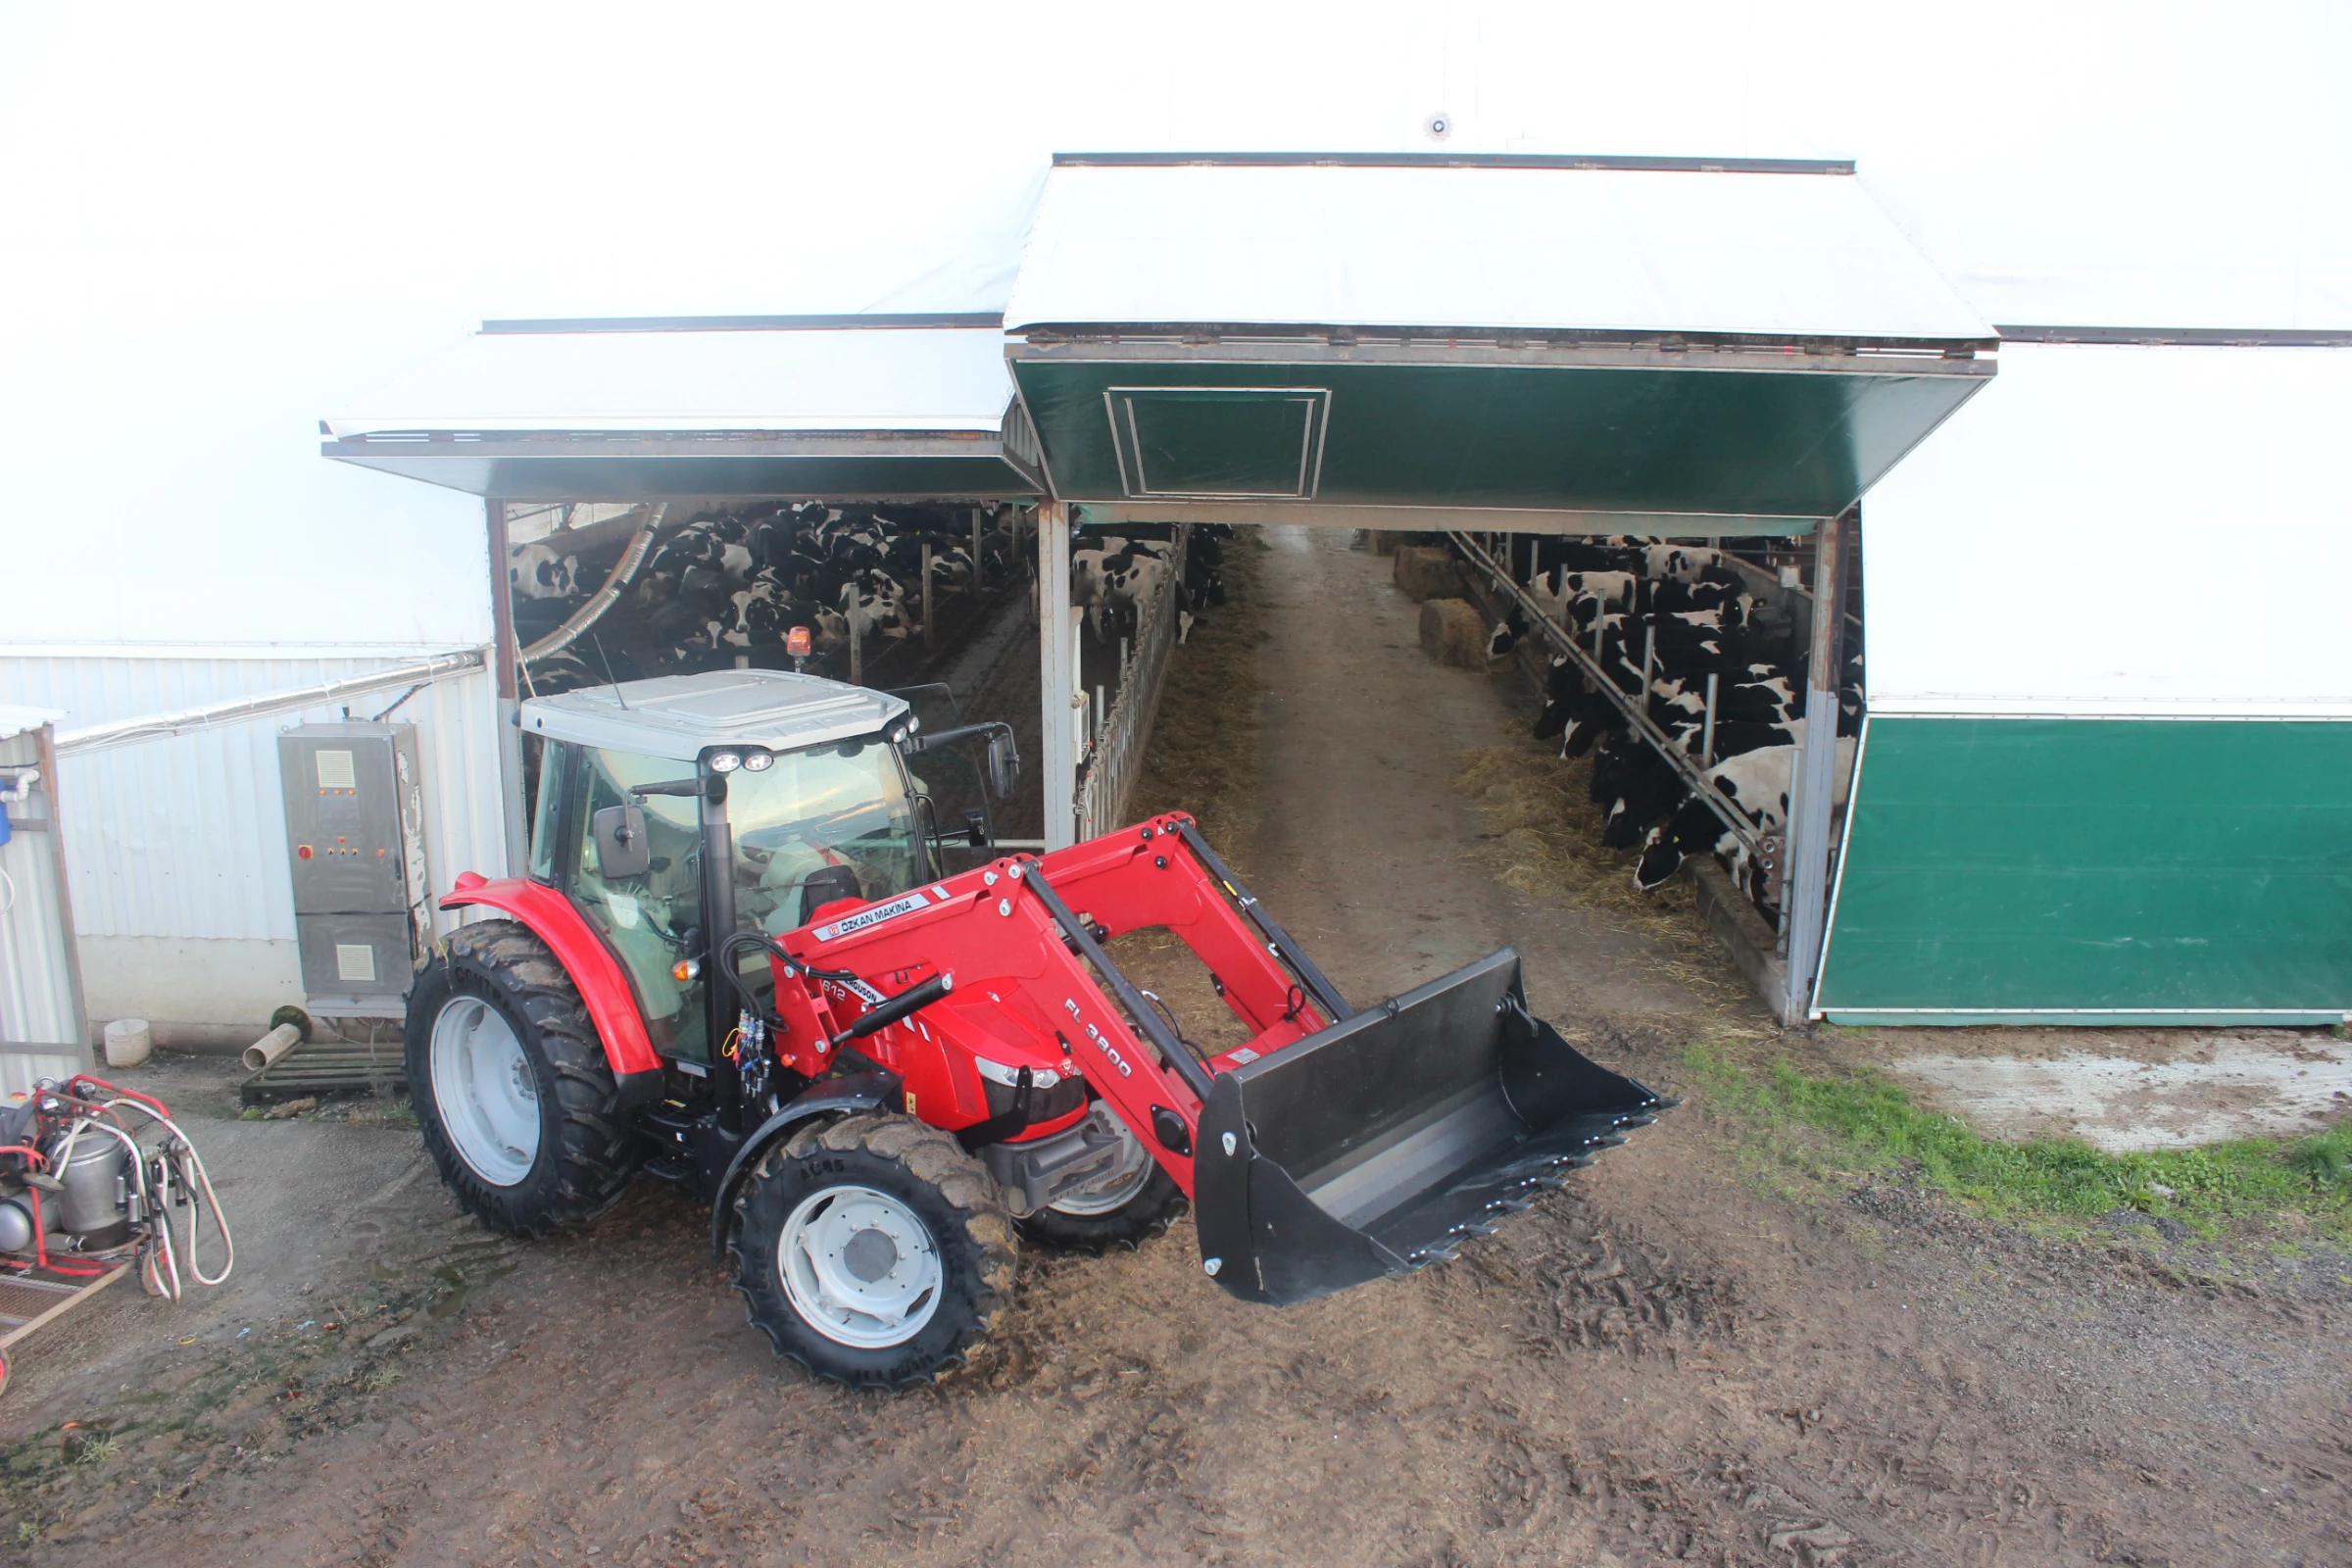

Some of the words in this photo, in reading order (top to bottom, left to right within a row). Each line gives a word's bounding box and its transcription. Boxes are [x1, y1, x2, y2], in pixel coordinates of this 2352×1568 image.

[841, 913, 873, 932] ÖZKAN
[874, 901, 912, 919] MAKİNA
[1063, 998, 1081, 1024] FL
[1085, 1022, 1132, 1078] 3800
